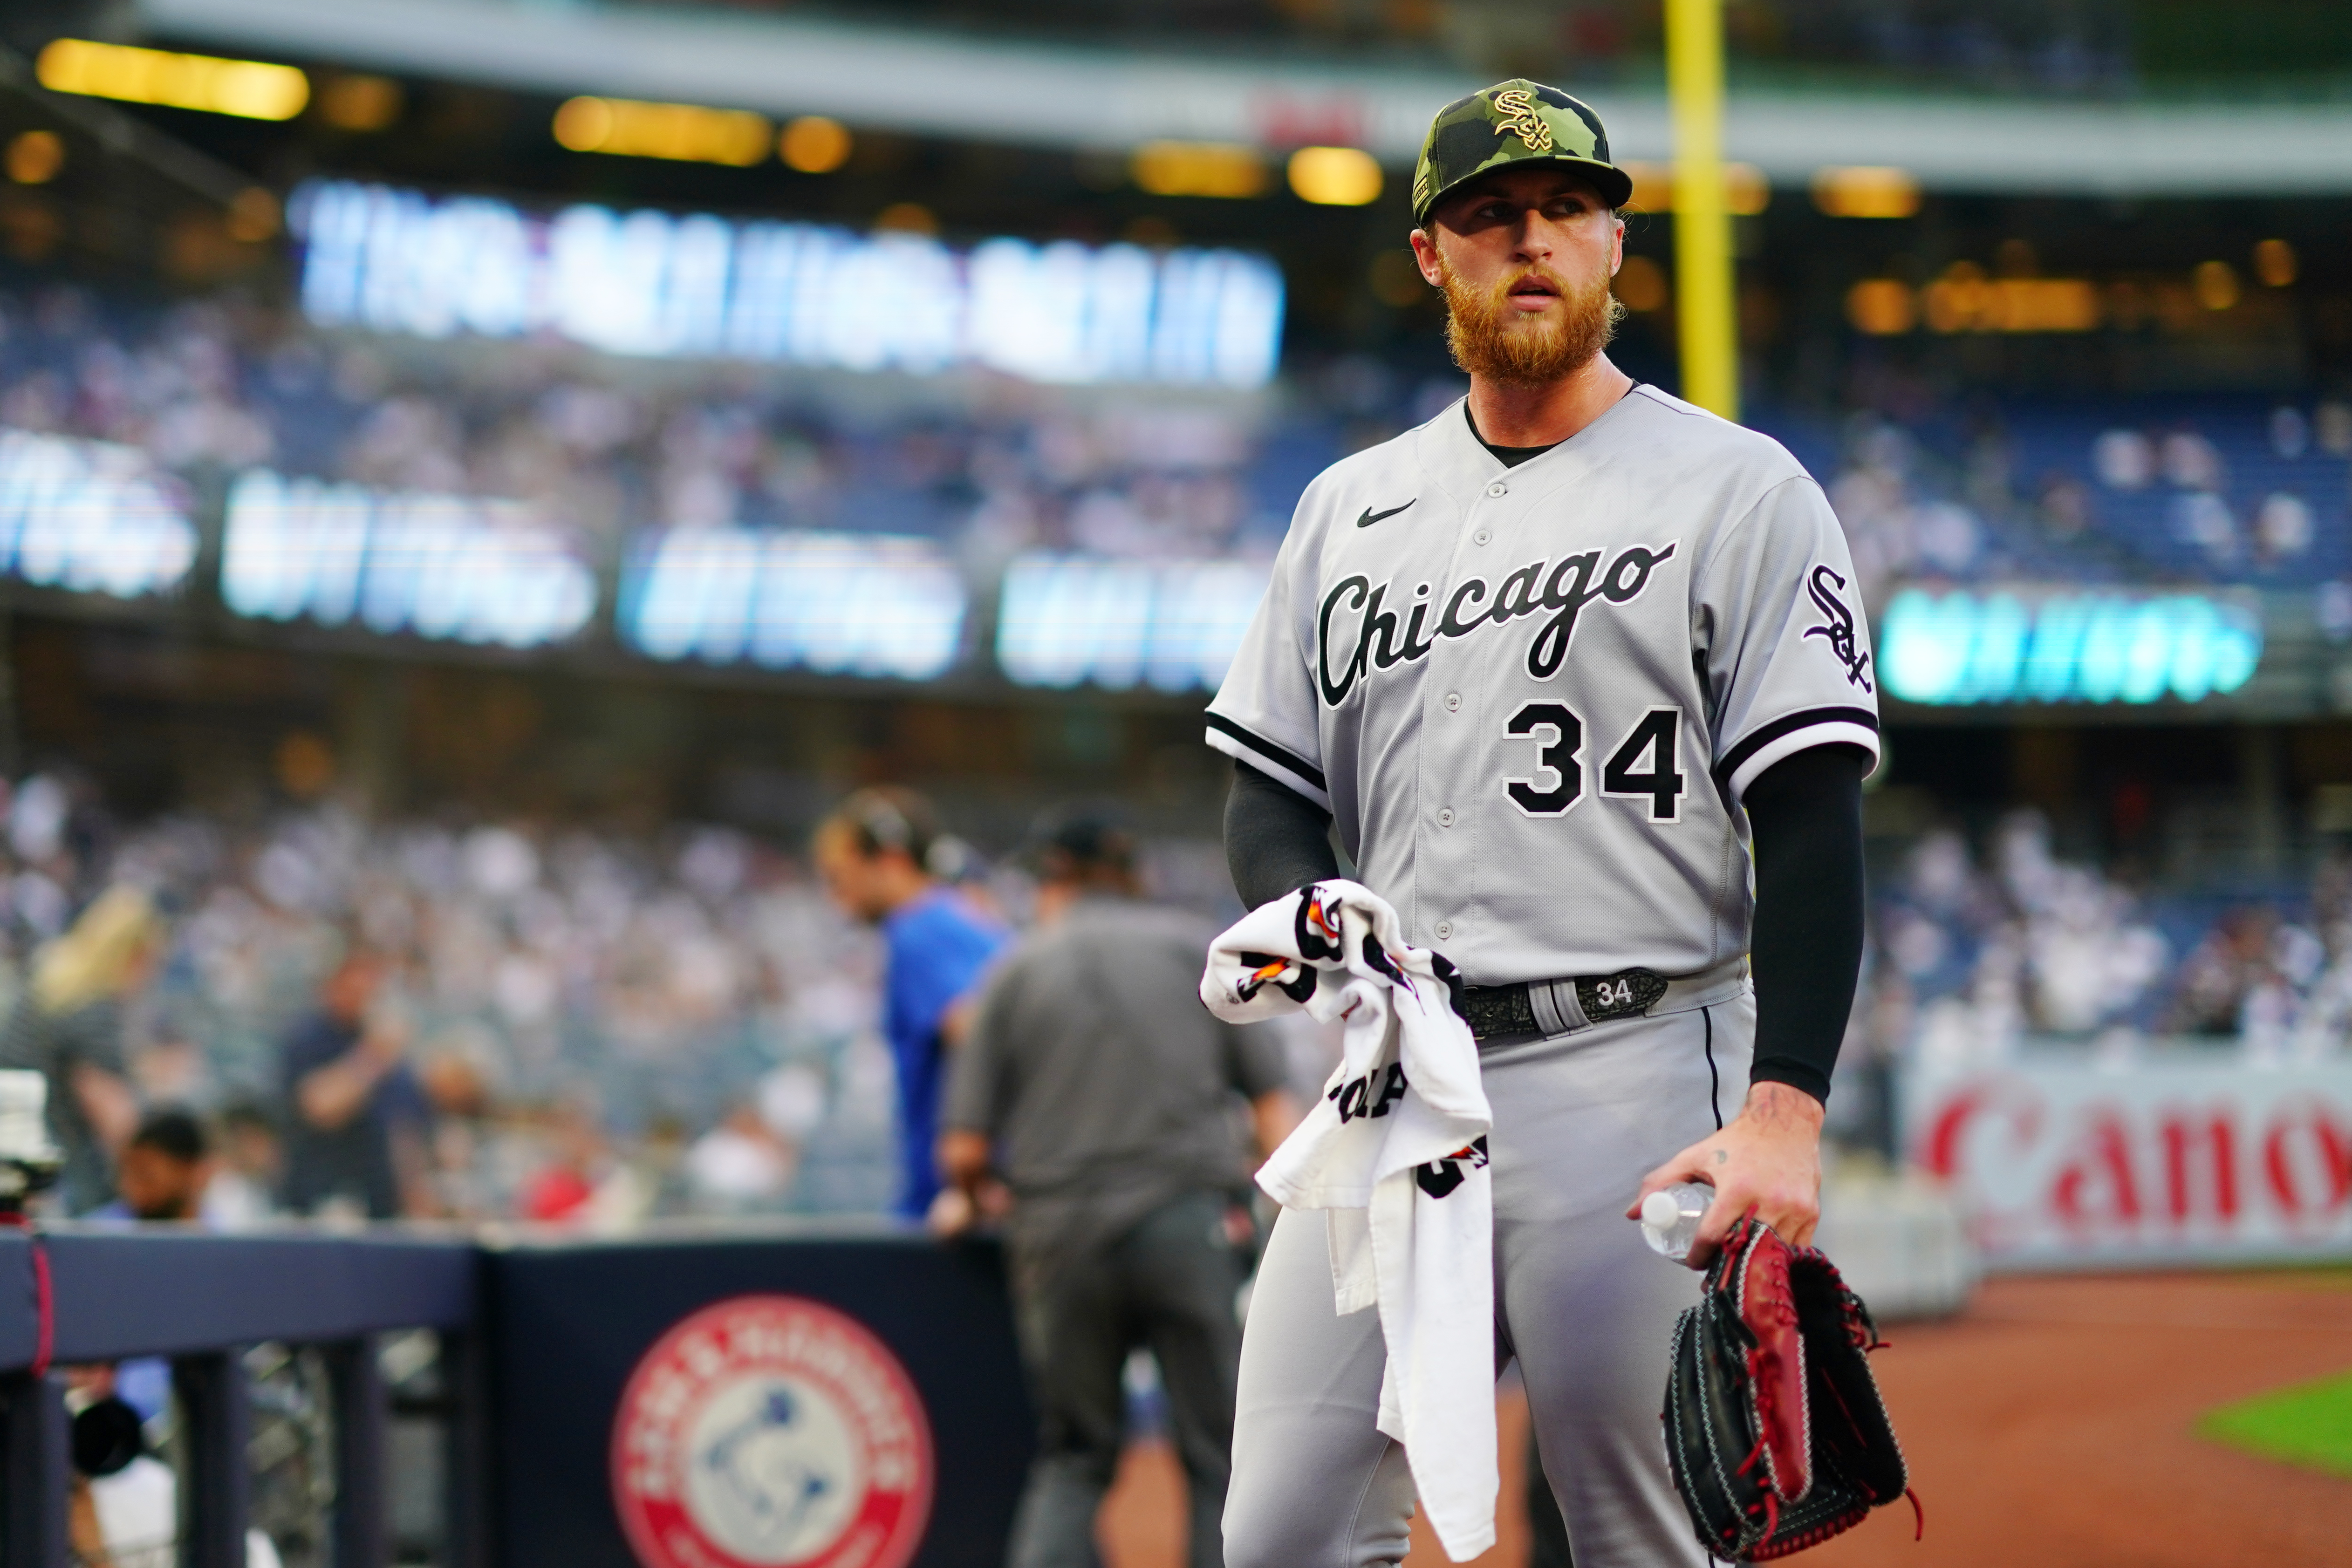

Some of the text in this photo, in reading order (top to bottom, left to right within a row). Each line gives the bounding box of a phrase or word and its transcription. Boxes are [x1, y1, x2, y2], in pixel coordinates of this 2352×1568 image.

[1494, 90, 1552, 151] Sox
[1317, 538, 1682, 710] Chicago
[1800, 563, 1872, 695] Sox
[1502, 699, 1688, 824] 34
[1596, 979, 1632, 1006] 34
